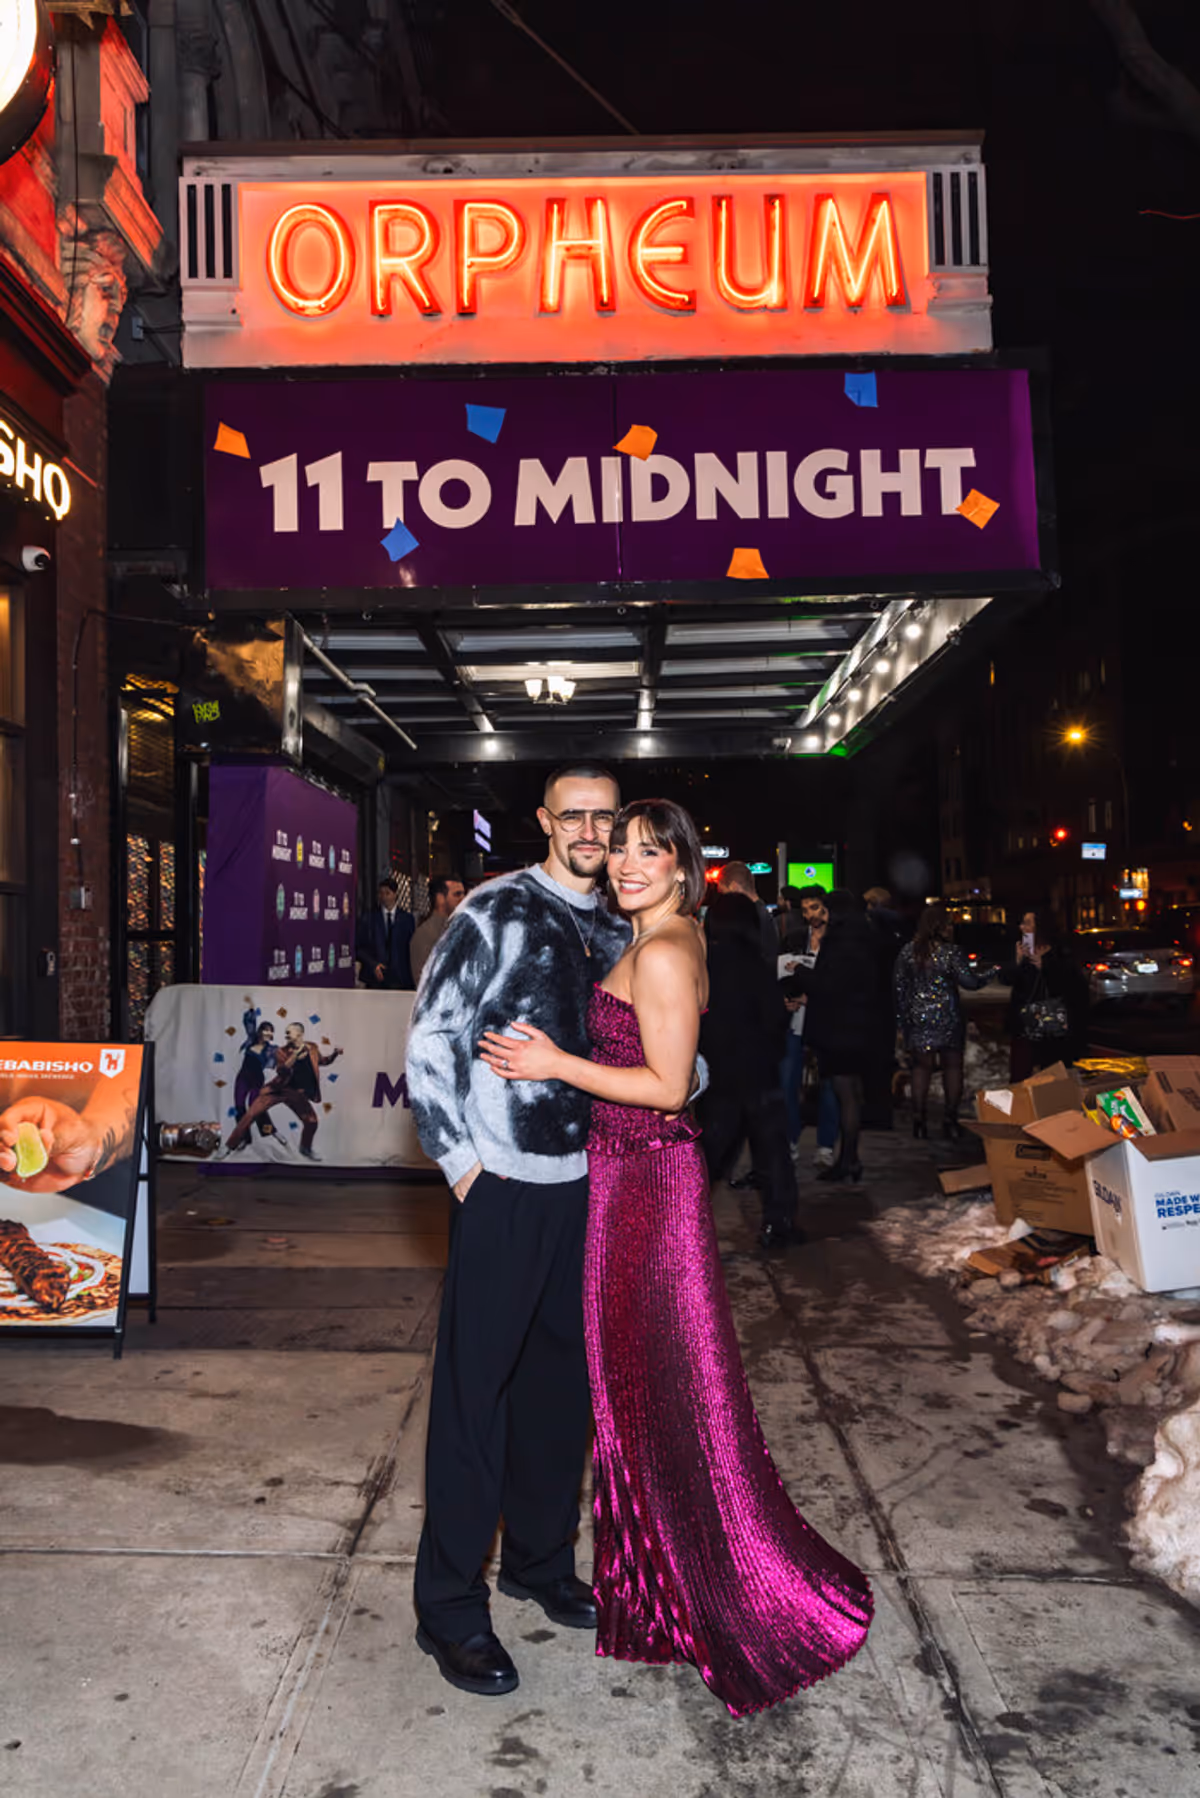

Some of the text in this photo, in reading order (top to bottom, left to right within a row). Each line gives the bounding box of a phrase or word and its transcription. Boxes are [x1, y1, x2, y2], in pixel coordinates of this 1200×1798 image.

[267, 192, 907, 318] ORPHEUM
[259, 447, 977, 533] 11 TO MIDNIGHT
[1155, 1195, 1187, 1208] MADE
[1157, 1203, 1200, 1219] RESPE
